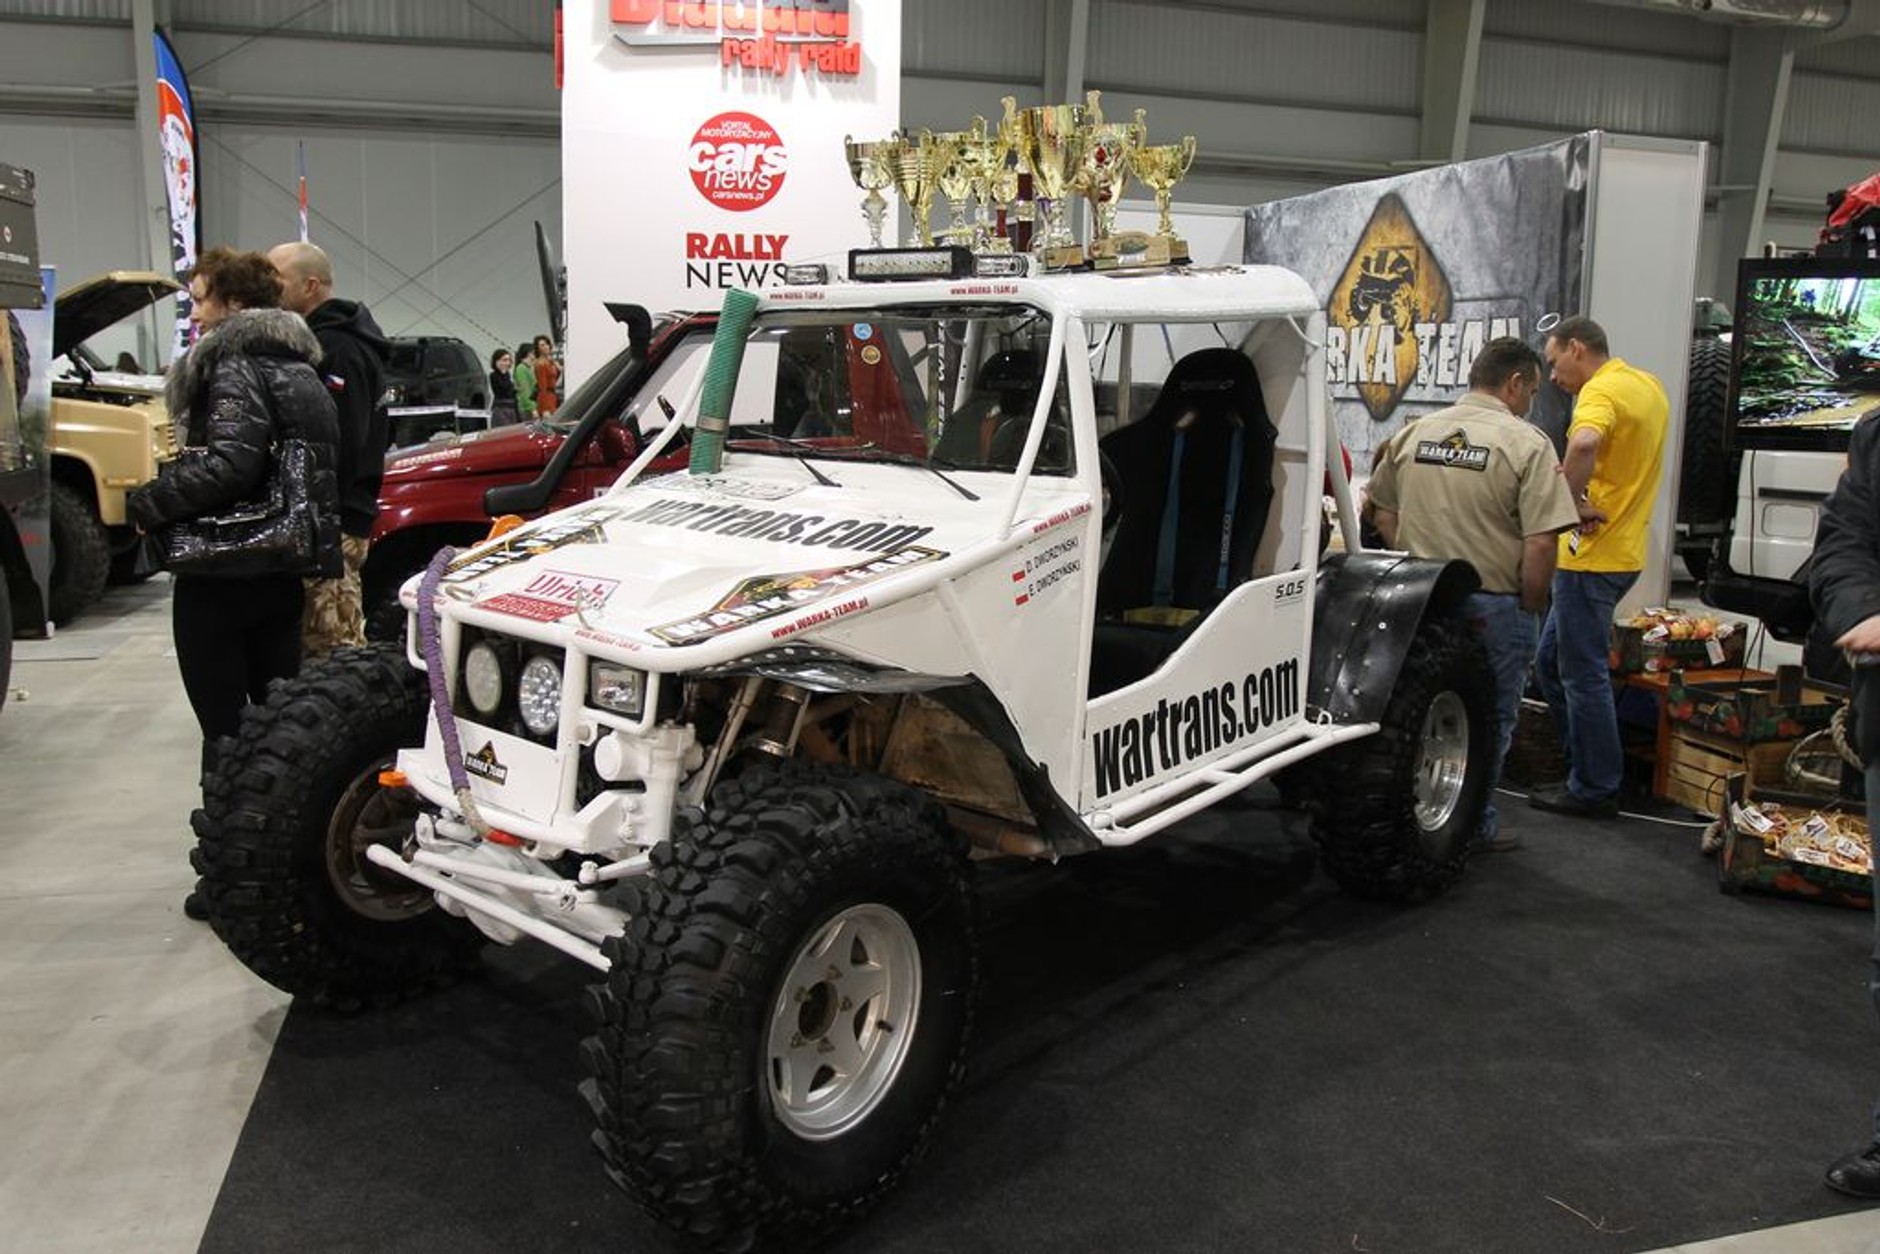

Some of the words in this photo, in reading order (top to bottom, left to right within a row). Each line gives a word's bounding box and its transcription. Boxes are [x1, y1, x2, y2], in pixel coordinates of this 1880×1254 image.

[722, 33, 790, 76] rally
[800, 41, 860, 75] raid
[688, 140, 788, 174] cars
[704, 169, 772, 191] news
[686, 232, 789, 260] RALLY
[686, 261, 787, 288] NEWS
[1326, 325, 1397, 385] RKA
[1420, 445, 1455, 460] WARKA
[1458, 449, 1487, 464] TEAM
[619, 498, 935, 552] wartrans.com
[664, 586, 825, 638] WARKA
[820, 548, 930, 586] TEAM
[1092, 656, 1300, 799] wartrans.com
